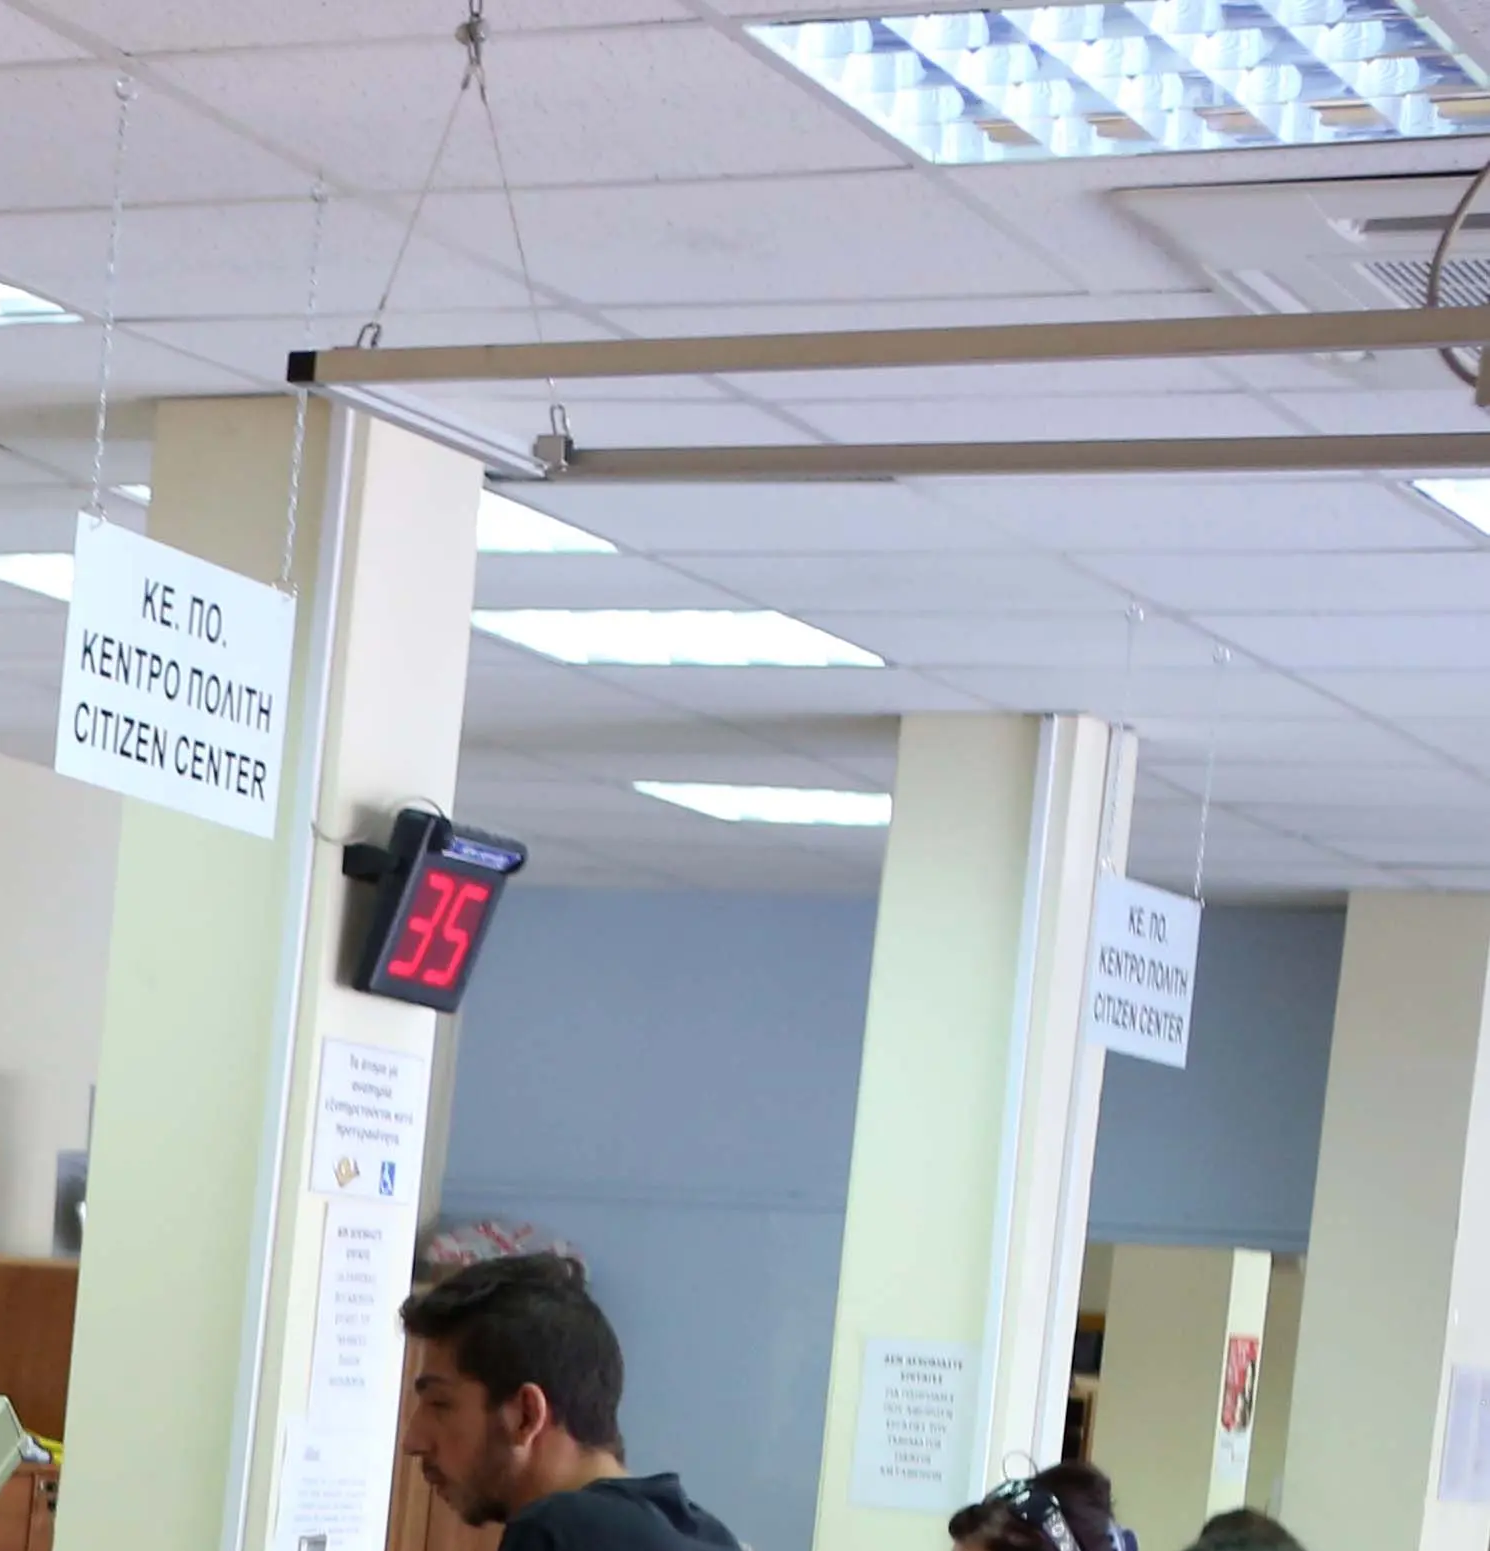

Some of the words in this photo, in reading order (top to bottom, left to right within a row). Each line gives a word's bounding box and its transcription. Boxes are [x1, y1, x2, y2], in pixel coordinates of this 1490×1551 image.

[141, 577, 180, 631] ΚΕ.
[187, 594, 228, 649] ΠΟ.
[80, 628, 182, 701] ΚΕΝΤΡΟ
[186, 666, 274, 734] ΠΟΛΙΤΗ
[73, 701, 168, 770] CITIZEN
[173, 735, 268, 802] CENTER
[386, 868, 491, 988] 35
[1093, 991, 1138, 1032] CITIZEN
[1138, 1003, 1184, 1044] CENTER
